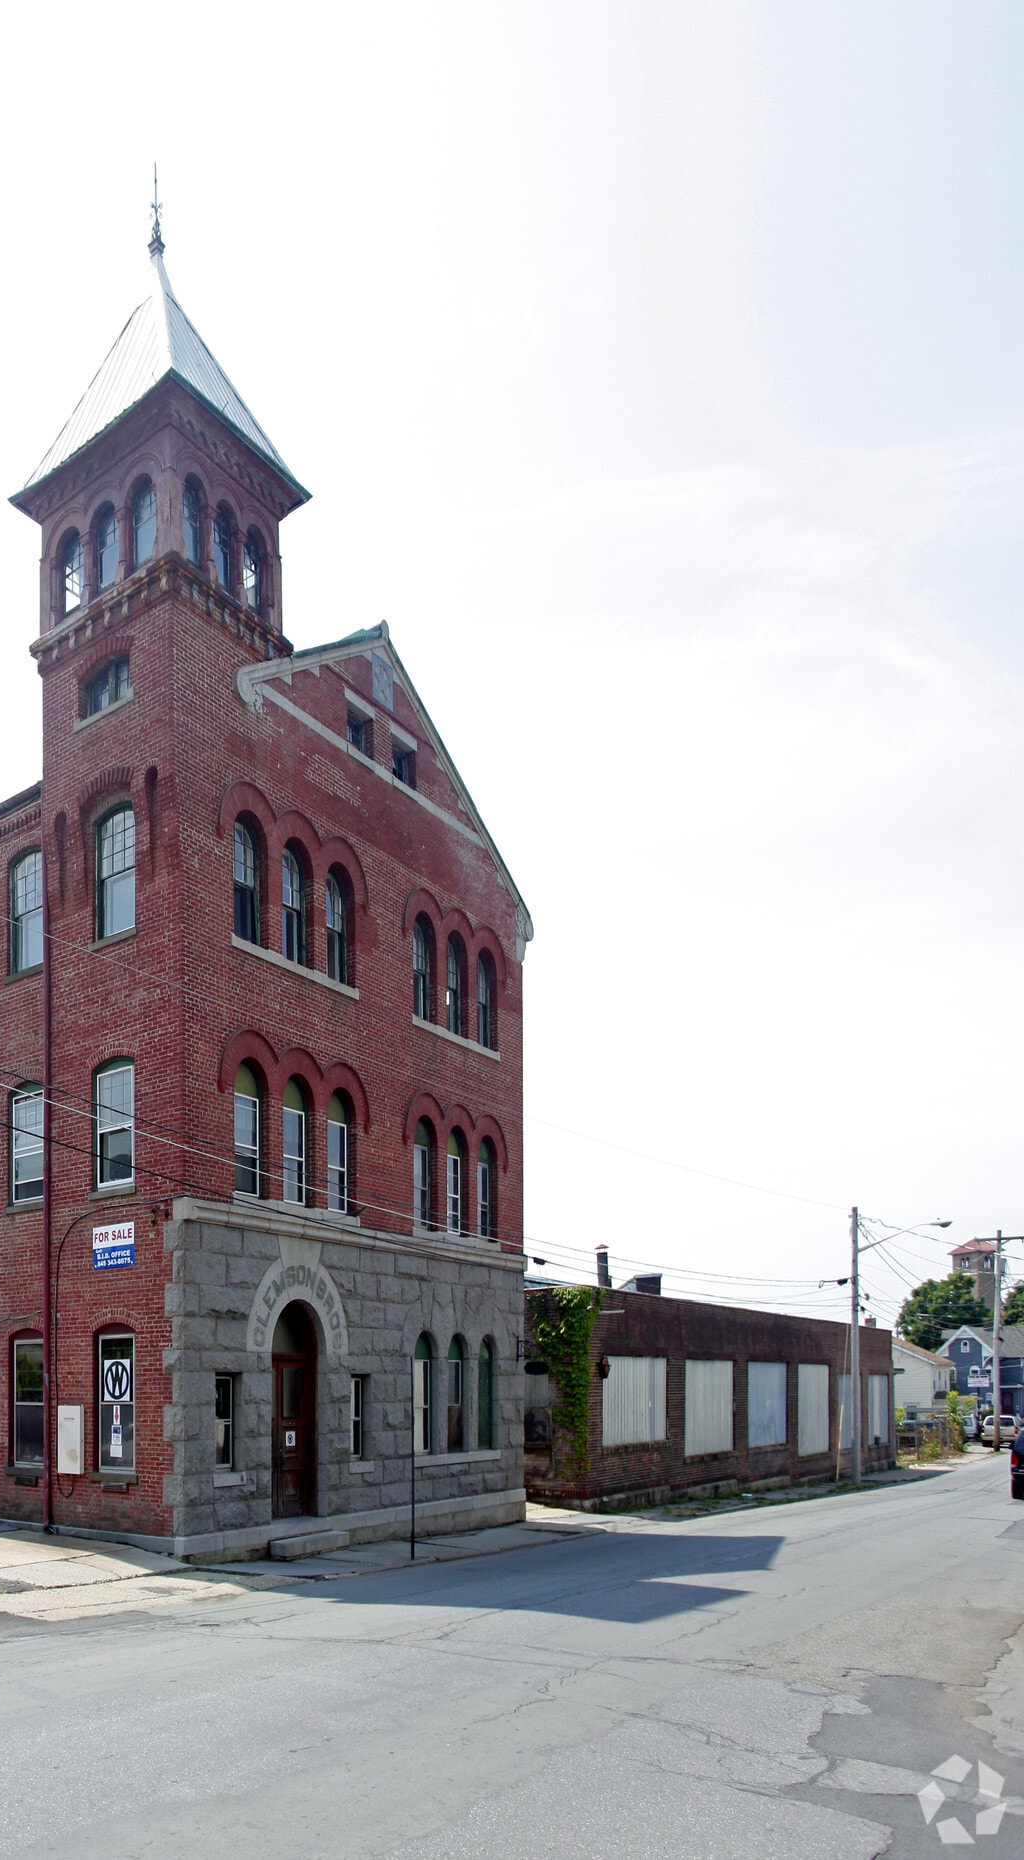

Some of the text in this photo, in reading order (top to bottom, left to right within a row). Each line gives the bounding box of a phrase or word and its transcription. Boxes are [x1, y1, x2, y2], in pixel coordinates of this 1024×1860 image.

[94, 1228, 133, 1243] FOR SALE
[111, 1249, 131, 1258] OFFICE
[253, 1265, 317, 1347] CLEMSON
